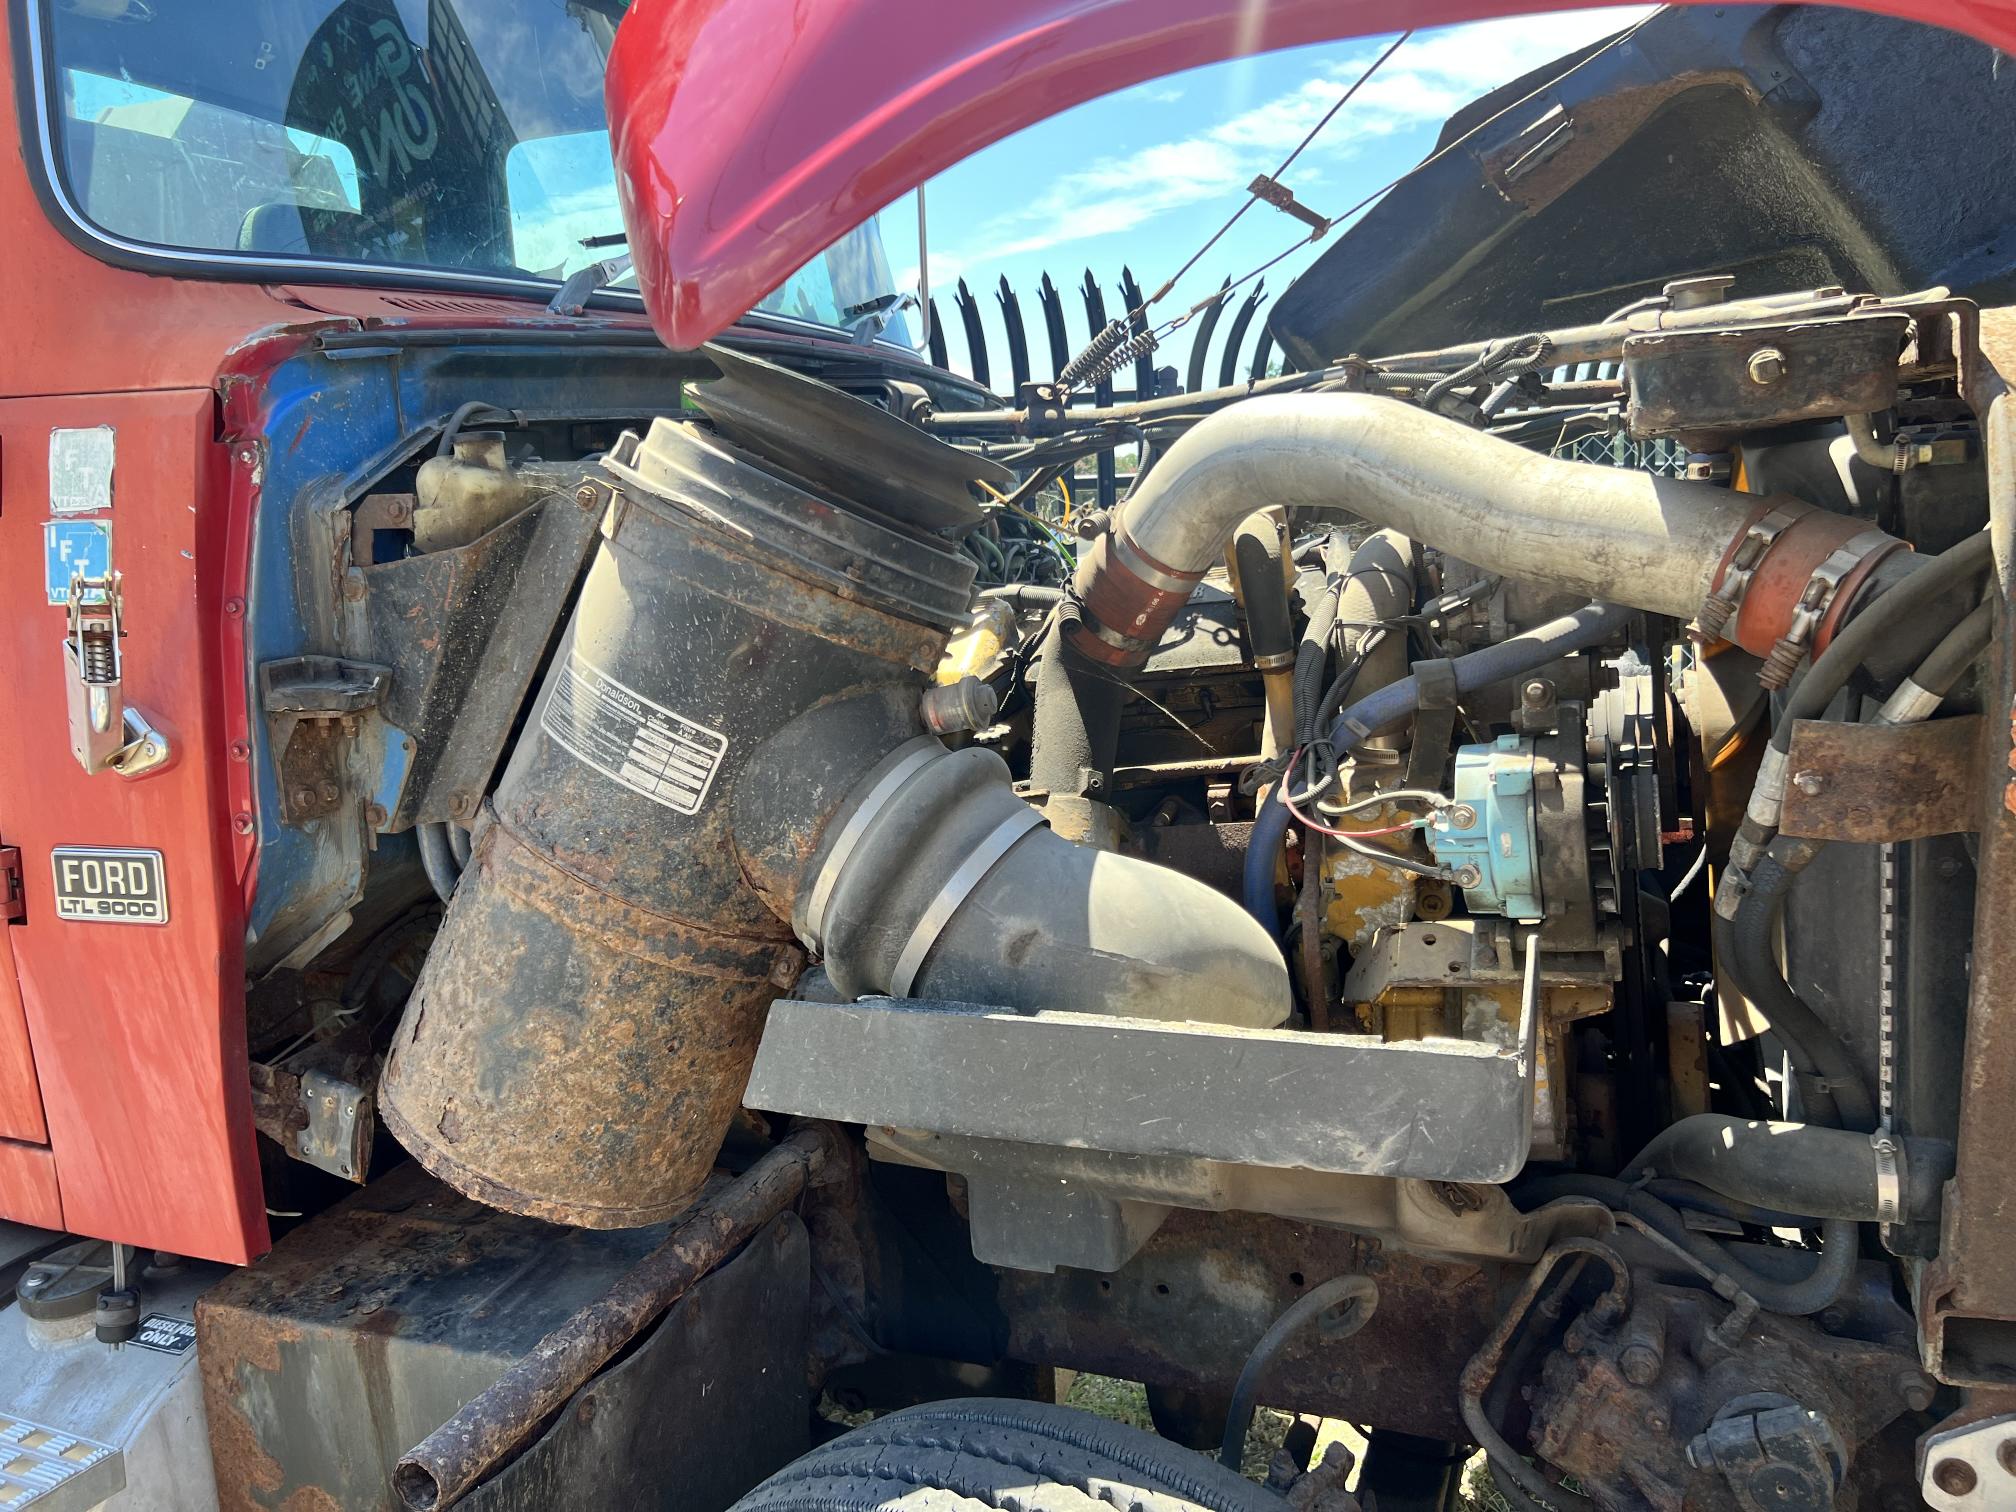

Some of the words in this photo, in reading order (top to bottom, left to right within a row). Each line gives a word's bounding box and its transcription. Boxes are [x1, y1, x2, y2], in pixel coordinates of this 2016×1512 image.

[595, 678, 641, 713] Donaldson
[647, 714, 670, 730] Cleaner
[656, 711, 666, 721] Air
[680, 723, 697, 736] Filtre
[62, 859, 148, 895] FORD
[60, 899, 93, 914] LTL
[97, 900, 157, 916] 9000
[143, 1318, 179, 1332] DIESEL
[179, 1323, 196, 1337] FUE
[140, 1330, 181, 1347] ONLY
